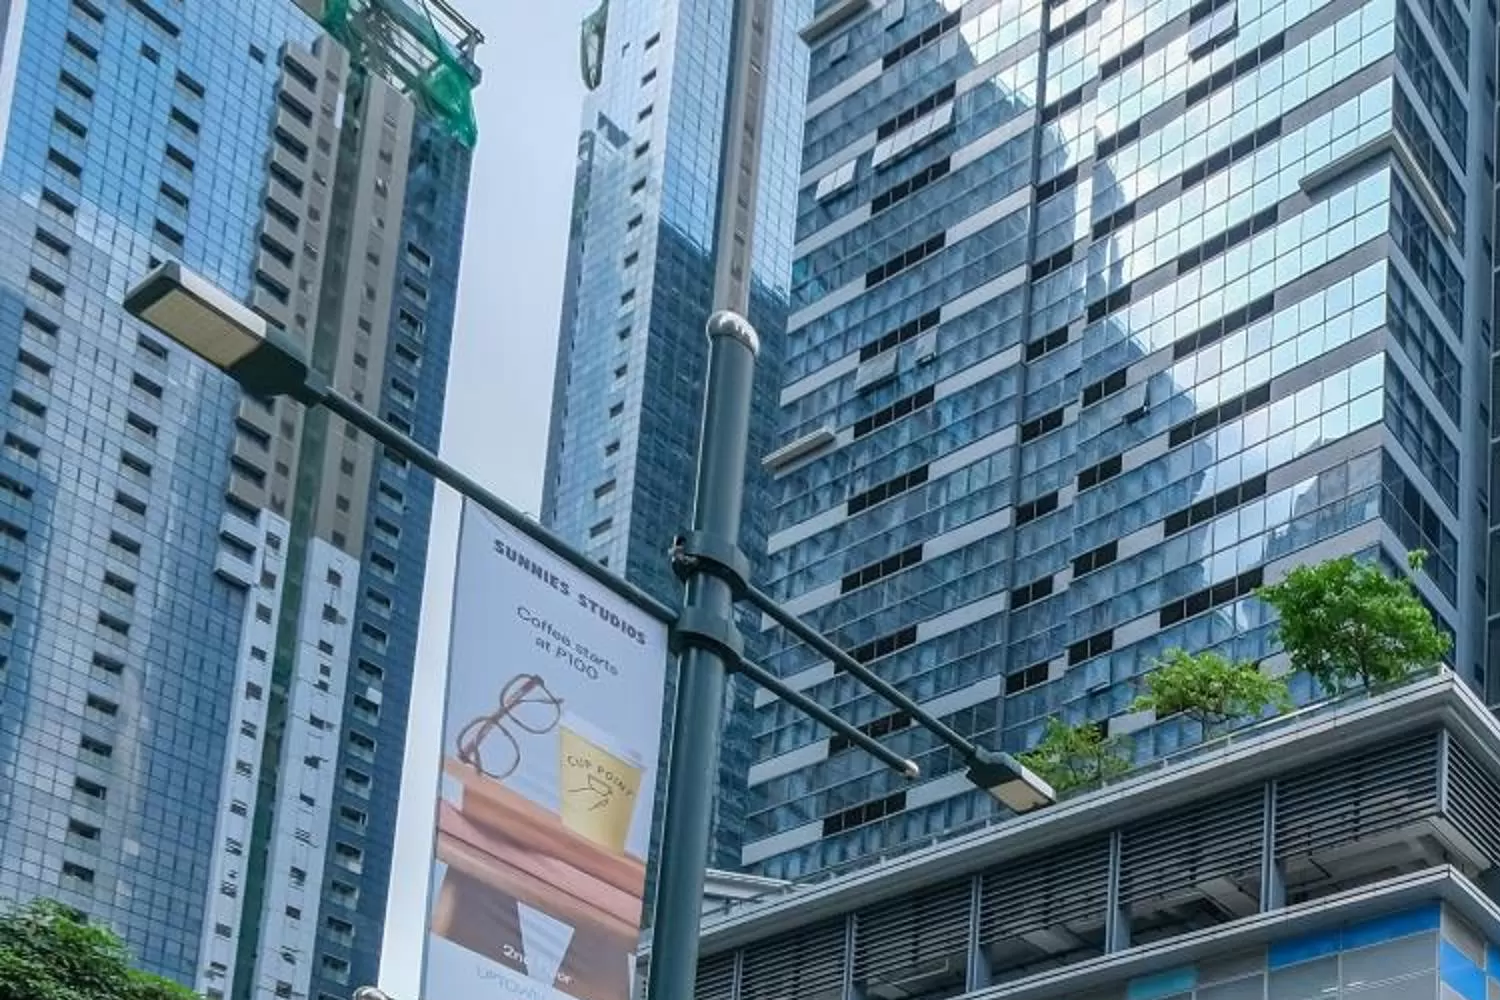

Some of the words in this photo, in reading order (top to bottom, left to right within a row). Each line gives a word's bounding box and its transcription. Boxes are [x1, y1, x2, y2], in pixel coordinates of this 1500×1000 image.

[493, 539, 570, 597] SUNNIES
[577, 594, 647, 645] STUDIOS
[516, 605, 571, 647] Coffee
[575, 642, 620, 677] starts
[535, 636, 551, 654] at
